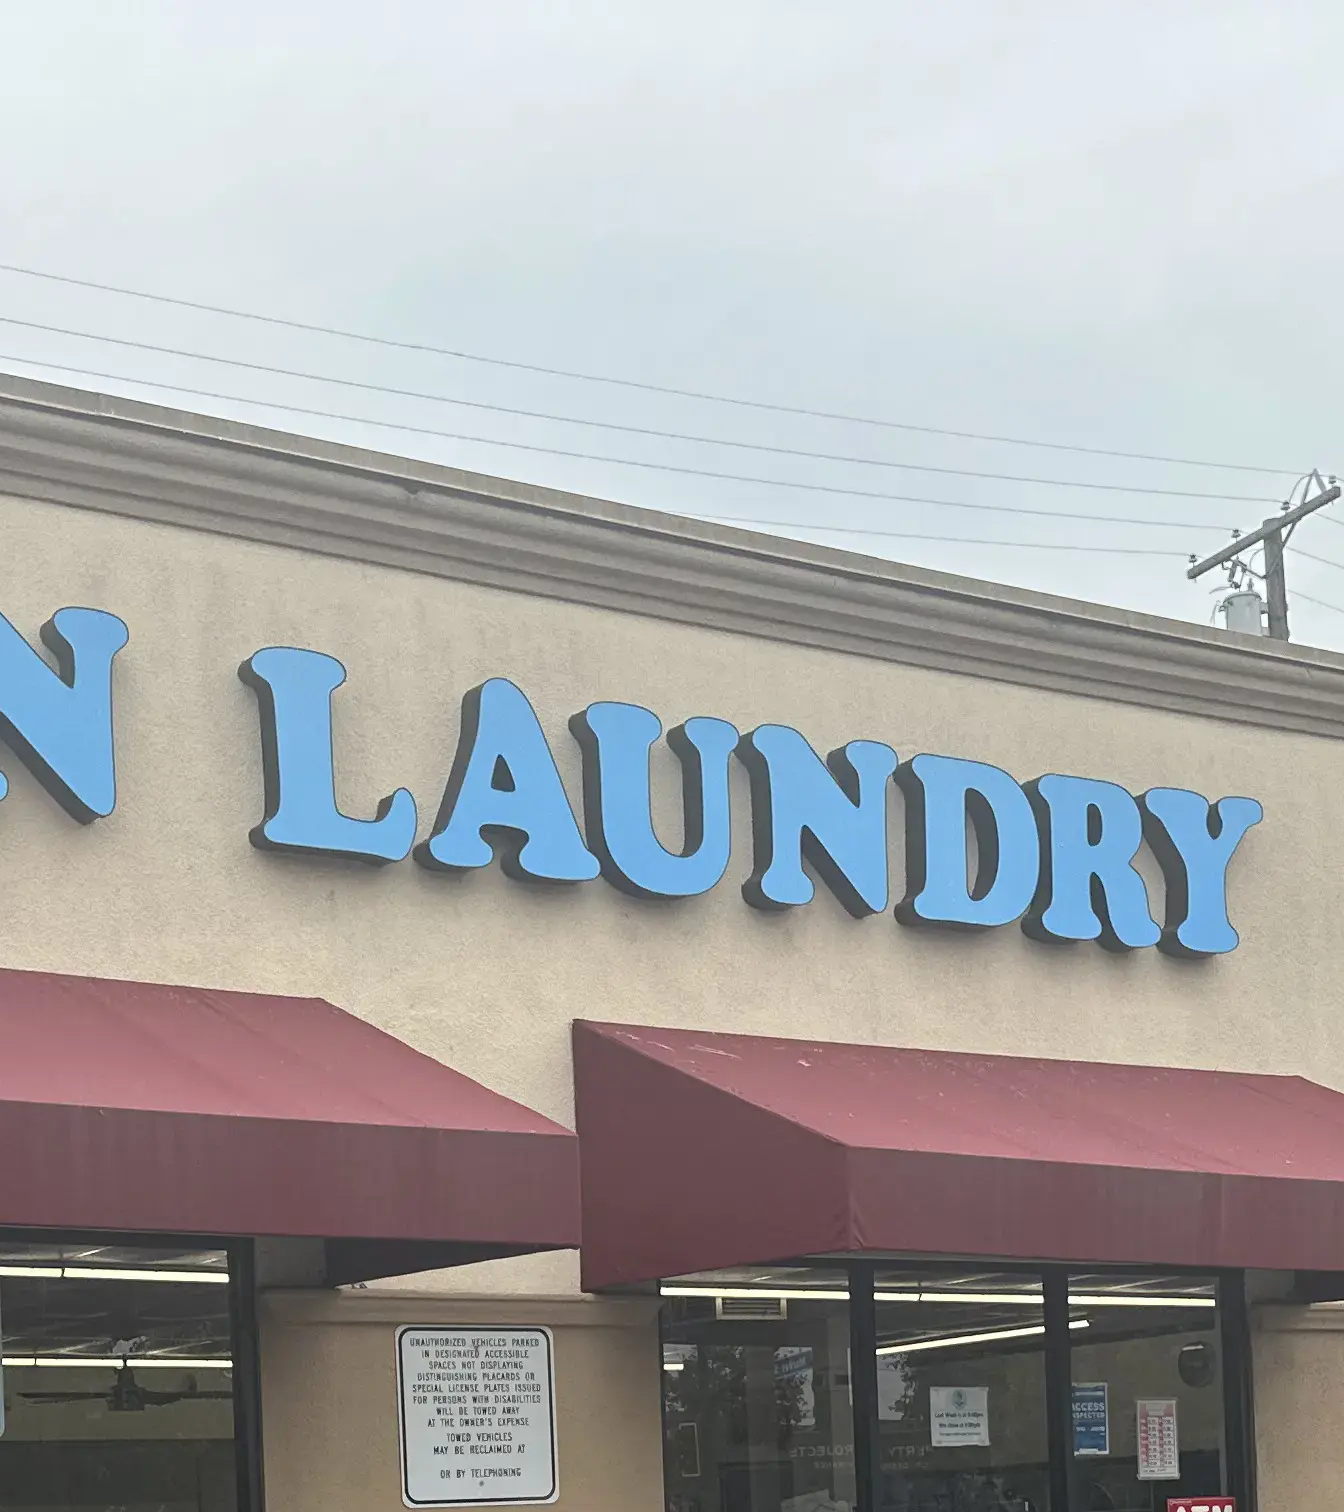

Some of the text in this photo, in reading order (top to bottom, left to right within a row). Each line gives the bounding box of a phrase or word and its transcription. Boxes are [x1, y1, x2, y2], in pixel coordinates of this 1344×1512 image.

[239, 646, 1263, 958] LAUNDRY
[410, 1338, 539, 1347] UNAUTHORIZED VEHICLES PARKED
[435, 1350, 479, 1358] DESIGNATED
[484, 1350, 529, 1358] ACCESSIBLE
[429, 1361, 523, 1370] SPACES NOT DISPLAYING
[417, 1372, 535, 1381] DISTINGUISHING PLACARDS OR
[412, 1384, 541, 1393] SPECIAL LICENSE PLATES ISSUED
[413, 1395, 427, 1404] FOR
[433, 1395, 467, 1404] PERSONS
[494, 1395, 541, 1404] DISABILITIES
[436, 1407, 520, 1416] WILL BE TOWED AWAY
[1072, 1411, 1105, 1419] SPECTED
[427, 1418, 529, 1427] AT THE OWNER'S EXPENSE
[446, 1432, 513, 1442] TOWED VEHICLES
[433, 1444, 526, 1455] MAY BE RECLAIMED AT
[440, 1467, 522, 1479] OR BY TELEPHONING
